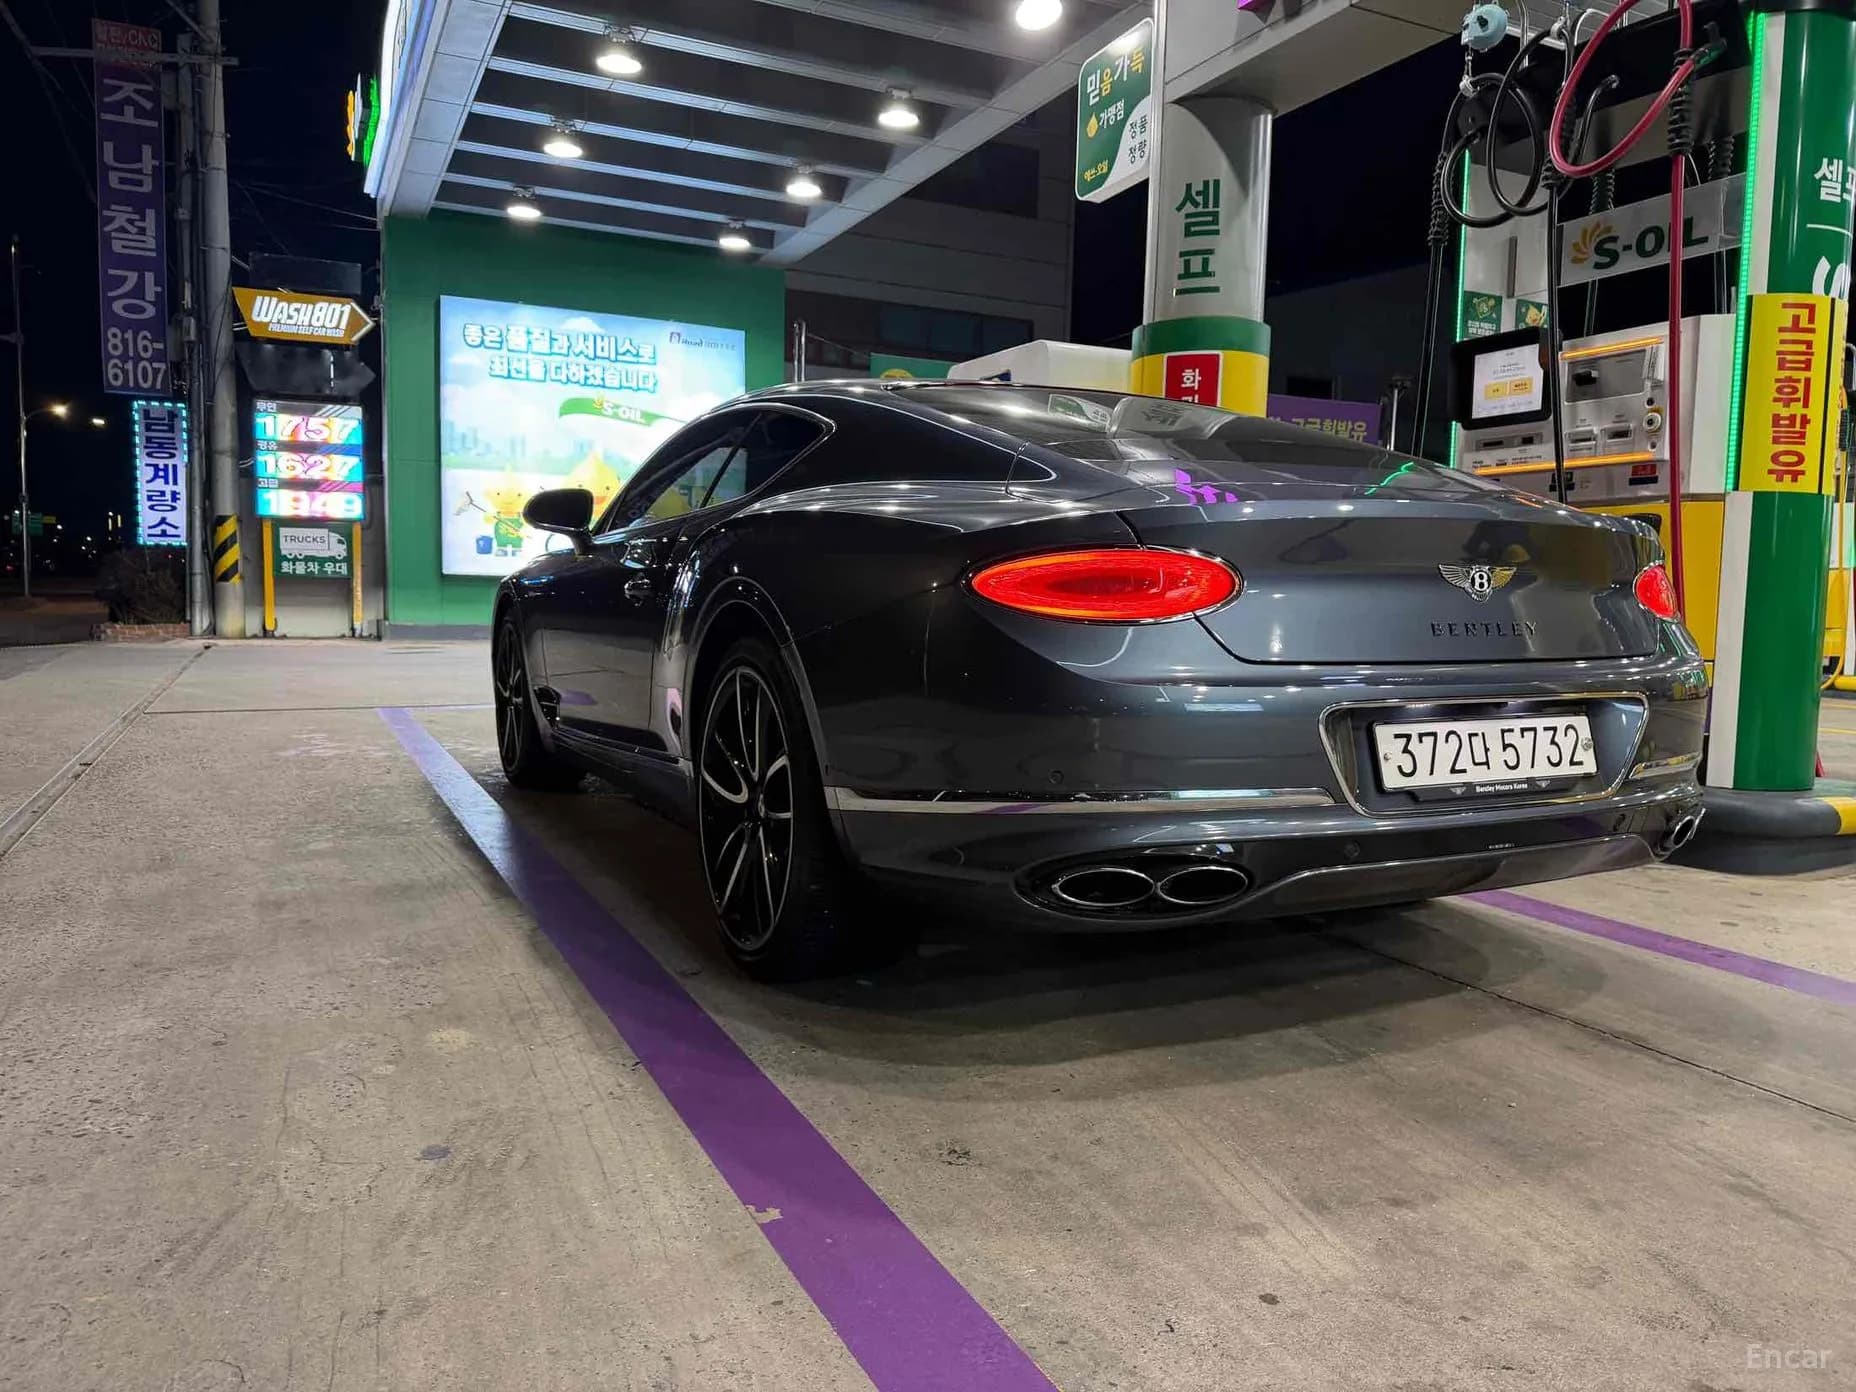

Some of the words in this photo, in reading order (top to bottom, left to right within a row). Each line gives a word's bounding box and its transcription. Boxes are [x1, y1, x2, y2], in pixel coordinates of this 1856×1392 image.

[1087, 49, 1144, 106] 믿음가득
[1099, 99, 1125, 128] 가맹점
[1129, 115, 1148, 139] 정품
[1128, 140, 1147, 164] 정량
[101, 79, 161, 319] 조남철강
[1173, 179, 1221, 297] 셀프
[1593, 216, 1709, 270] S-OL
[107, 327, 164, 358] 816-
[463, 323, 503, 350] 좋은
[506, 324, 569, 356] 품질과
[571, 333, 657, 365] 서비스로
[107, 358, 167, 389] 6107
[489, 354, 547, 382] 최선을
[550, 360, 657, 393] 다하겠습니다
[1767, 302, 1816, 483] 고급휘발유
[256, 413, 361, 444] 1757
[143, 409, 181, 538] 남동계량소
[257, 452, 361, 482] 1627
[283, 534, 327, 544] TRUCKS
[281, 561, 321, 575] 화물차
[323, 562, 348, 575] 우대
[1430, 620, 1537, 637] BENTLEY
[1393, 729, 1490, 778] 372다
[1500, 723, 1584, 771] 5732
